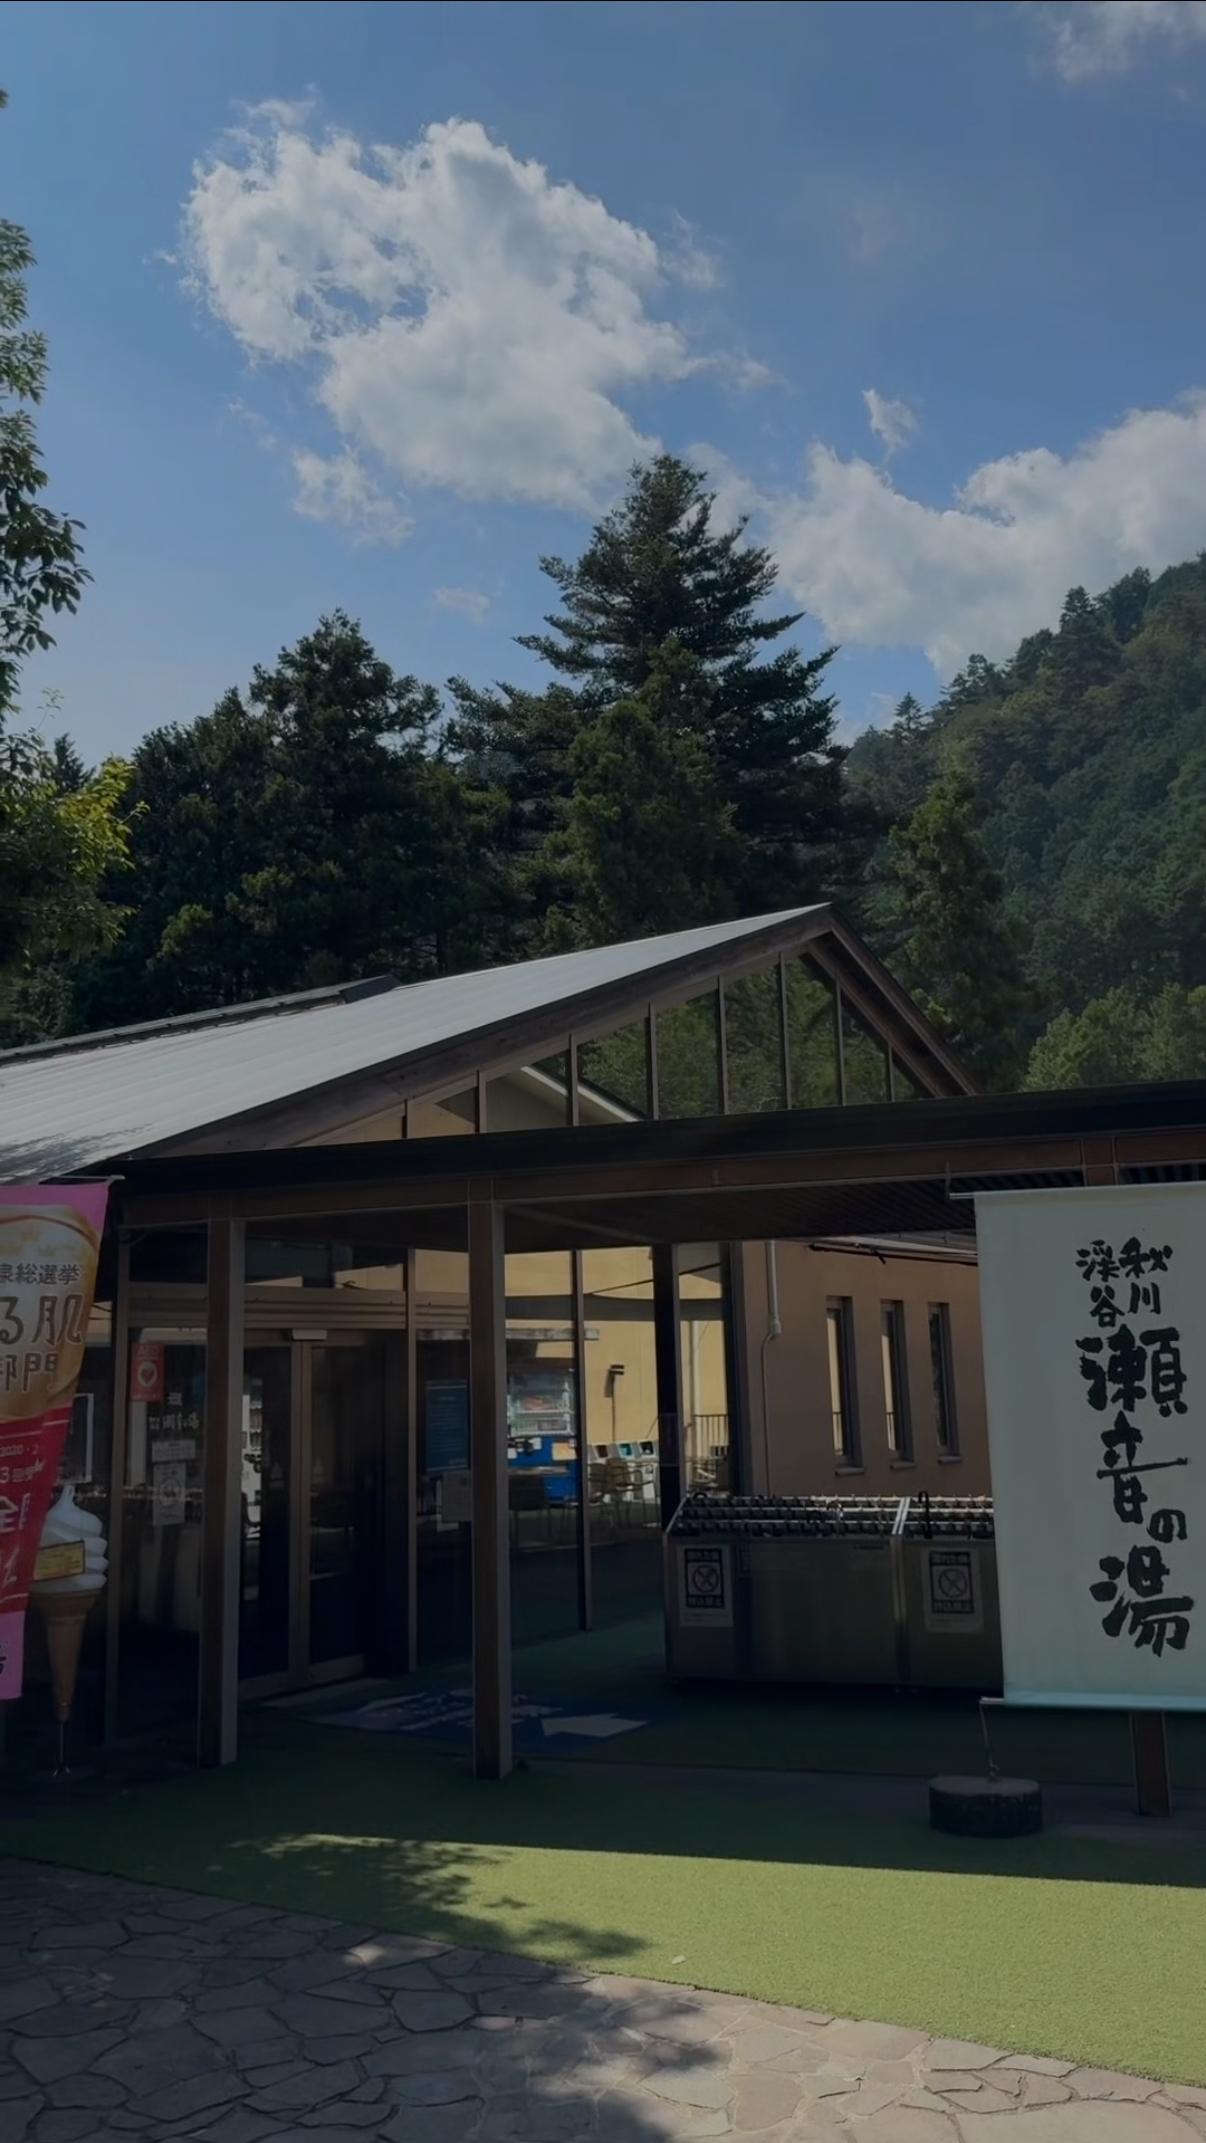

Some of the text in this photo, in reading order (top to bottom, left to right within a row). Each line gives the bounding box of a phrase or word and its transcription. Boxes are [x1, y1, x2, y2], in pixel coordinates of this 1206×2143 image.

[1075, 1240, 1125, 1327] 渓谷
[1118, 1237, 1173, 1314] 秋川
[1076, 1324, 1193, 1656] 瀬音の湯
